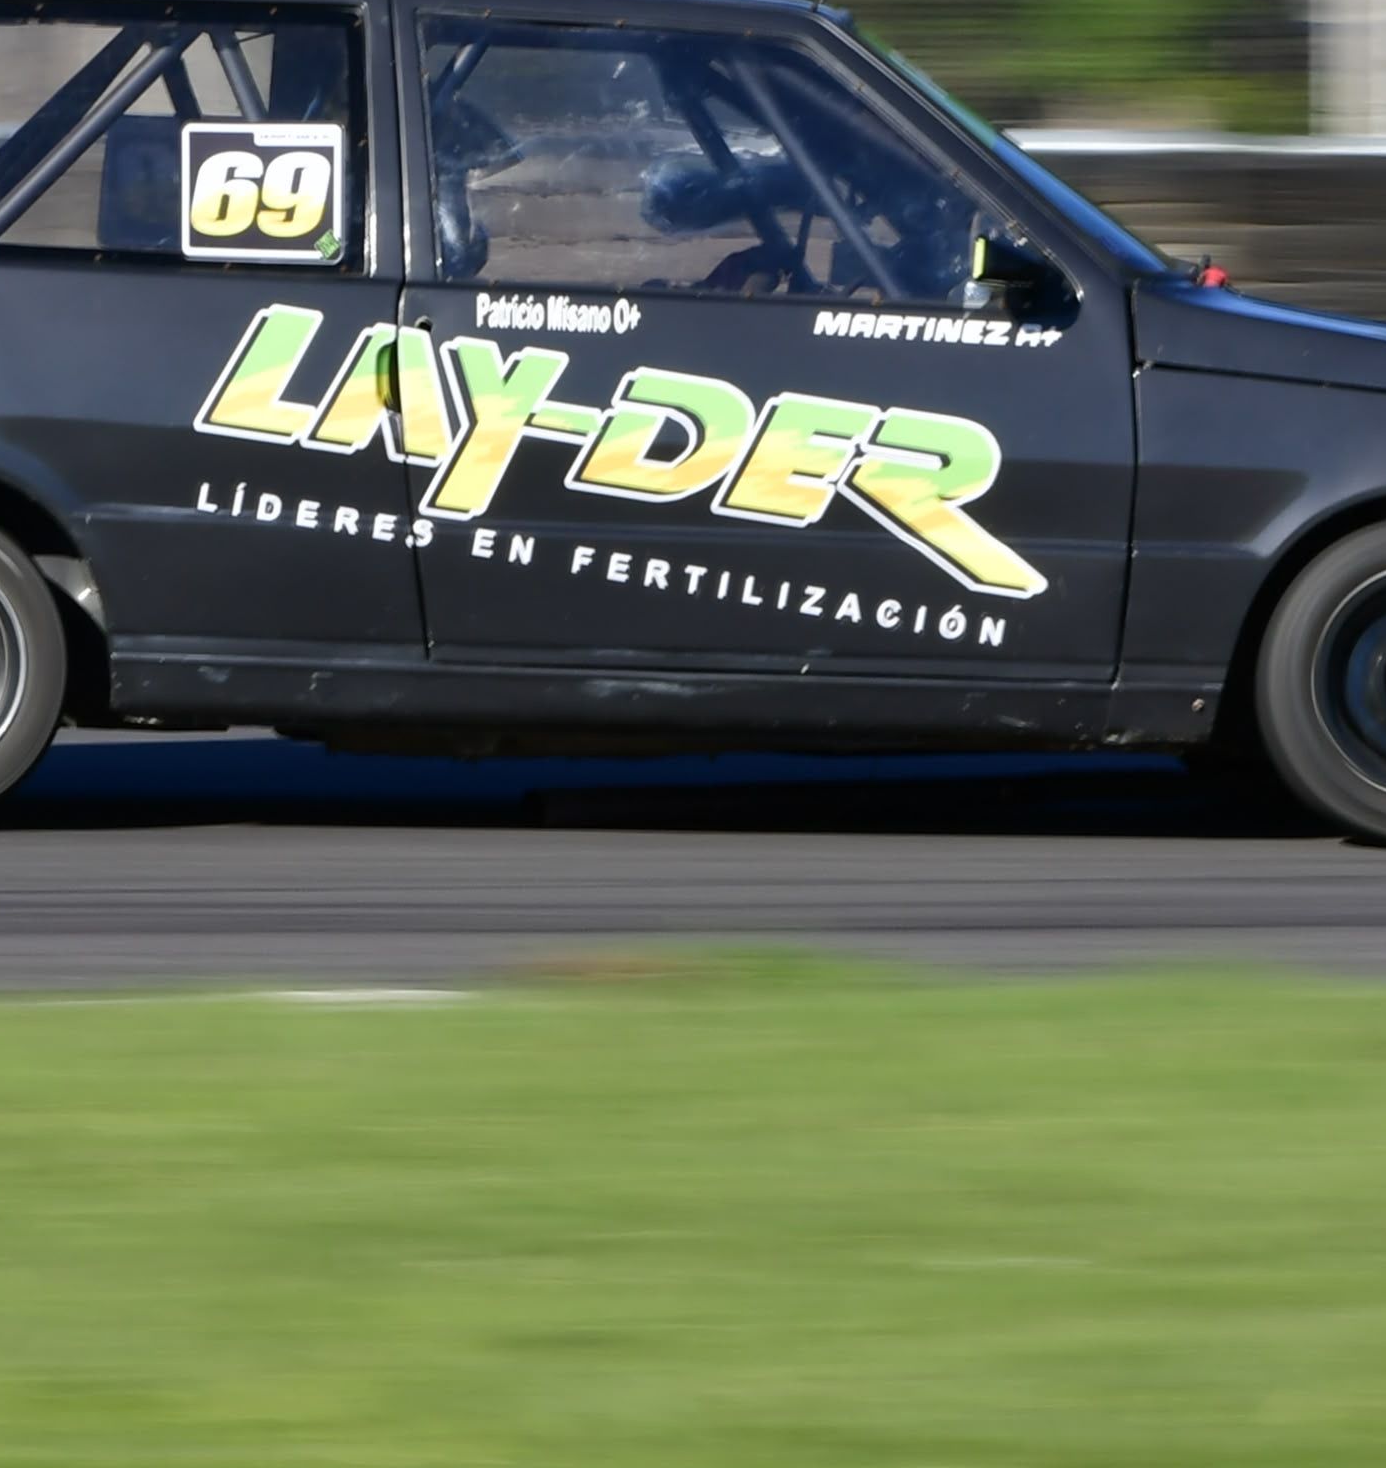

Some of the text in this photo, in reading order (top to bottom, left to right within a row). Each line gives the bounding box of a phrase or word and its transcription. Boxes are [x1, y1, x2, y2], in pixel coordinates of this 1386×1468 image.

[190, 150, 332, 238] 69
[475, 292, 546, 330] Patricio
[546, 295, 612, 334] Misano
[813, 310, 1013, 346] MARTINEZ
[193, 303, 1048, 600] LAY-DER
[196, 481, 1007, 647] LÍDERES EN FERTILIZACIÓN
